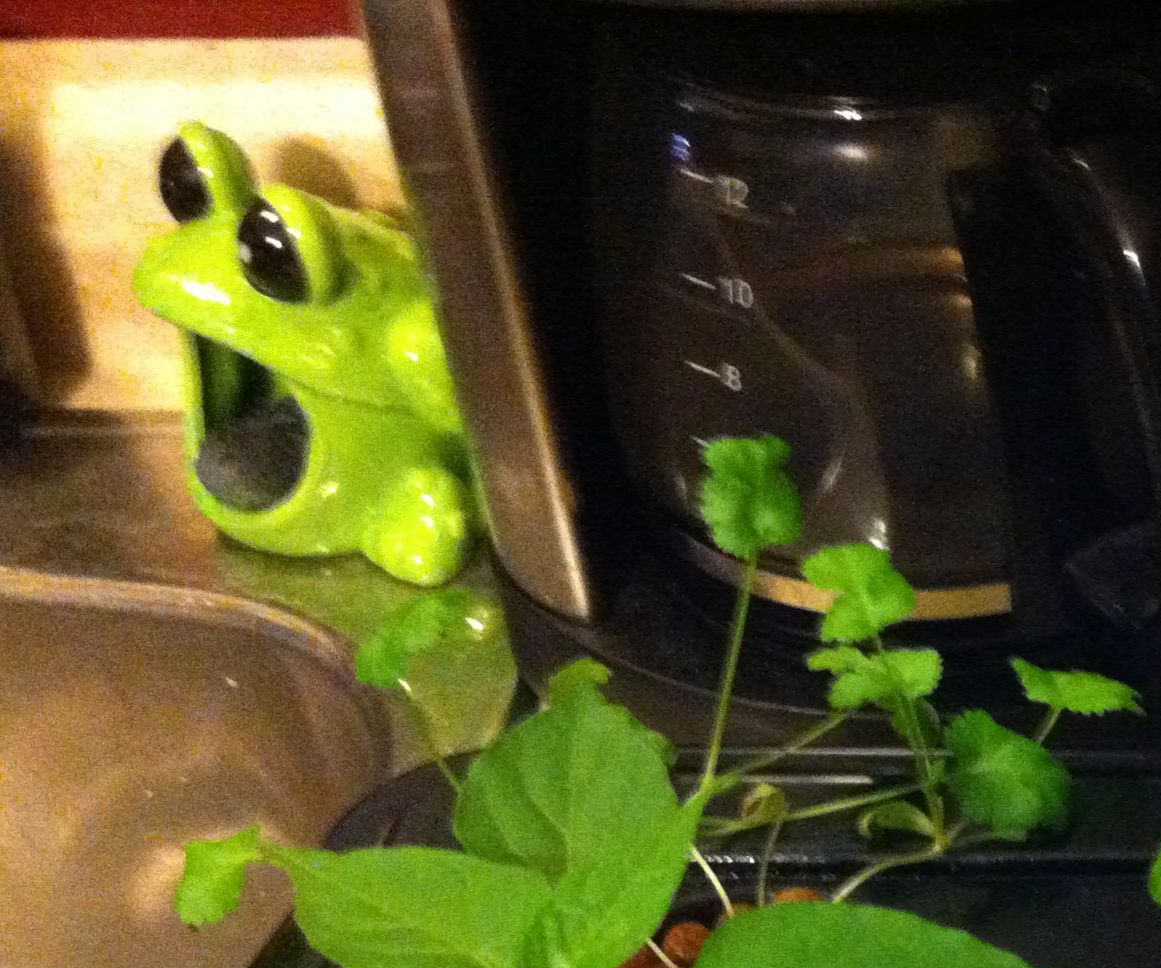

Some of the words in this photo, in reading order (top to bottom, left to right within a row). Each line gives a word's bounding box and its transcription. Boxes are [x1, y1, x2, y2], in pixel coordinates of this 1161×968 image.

[716, 176, 749, 209] 12
[721, 278, 754, 308] 10
[722, 363, 743, 392] 8
